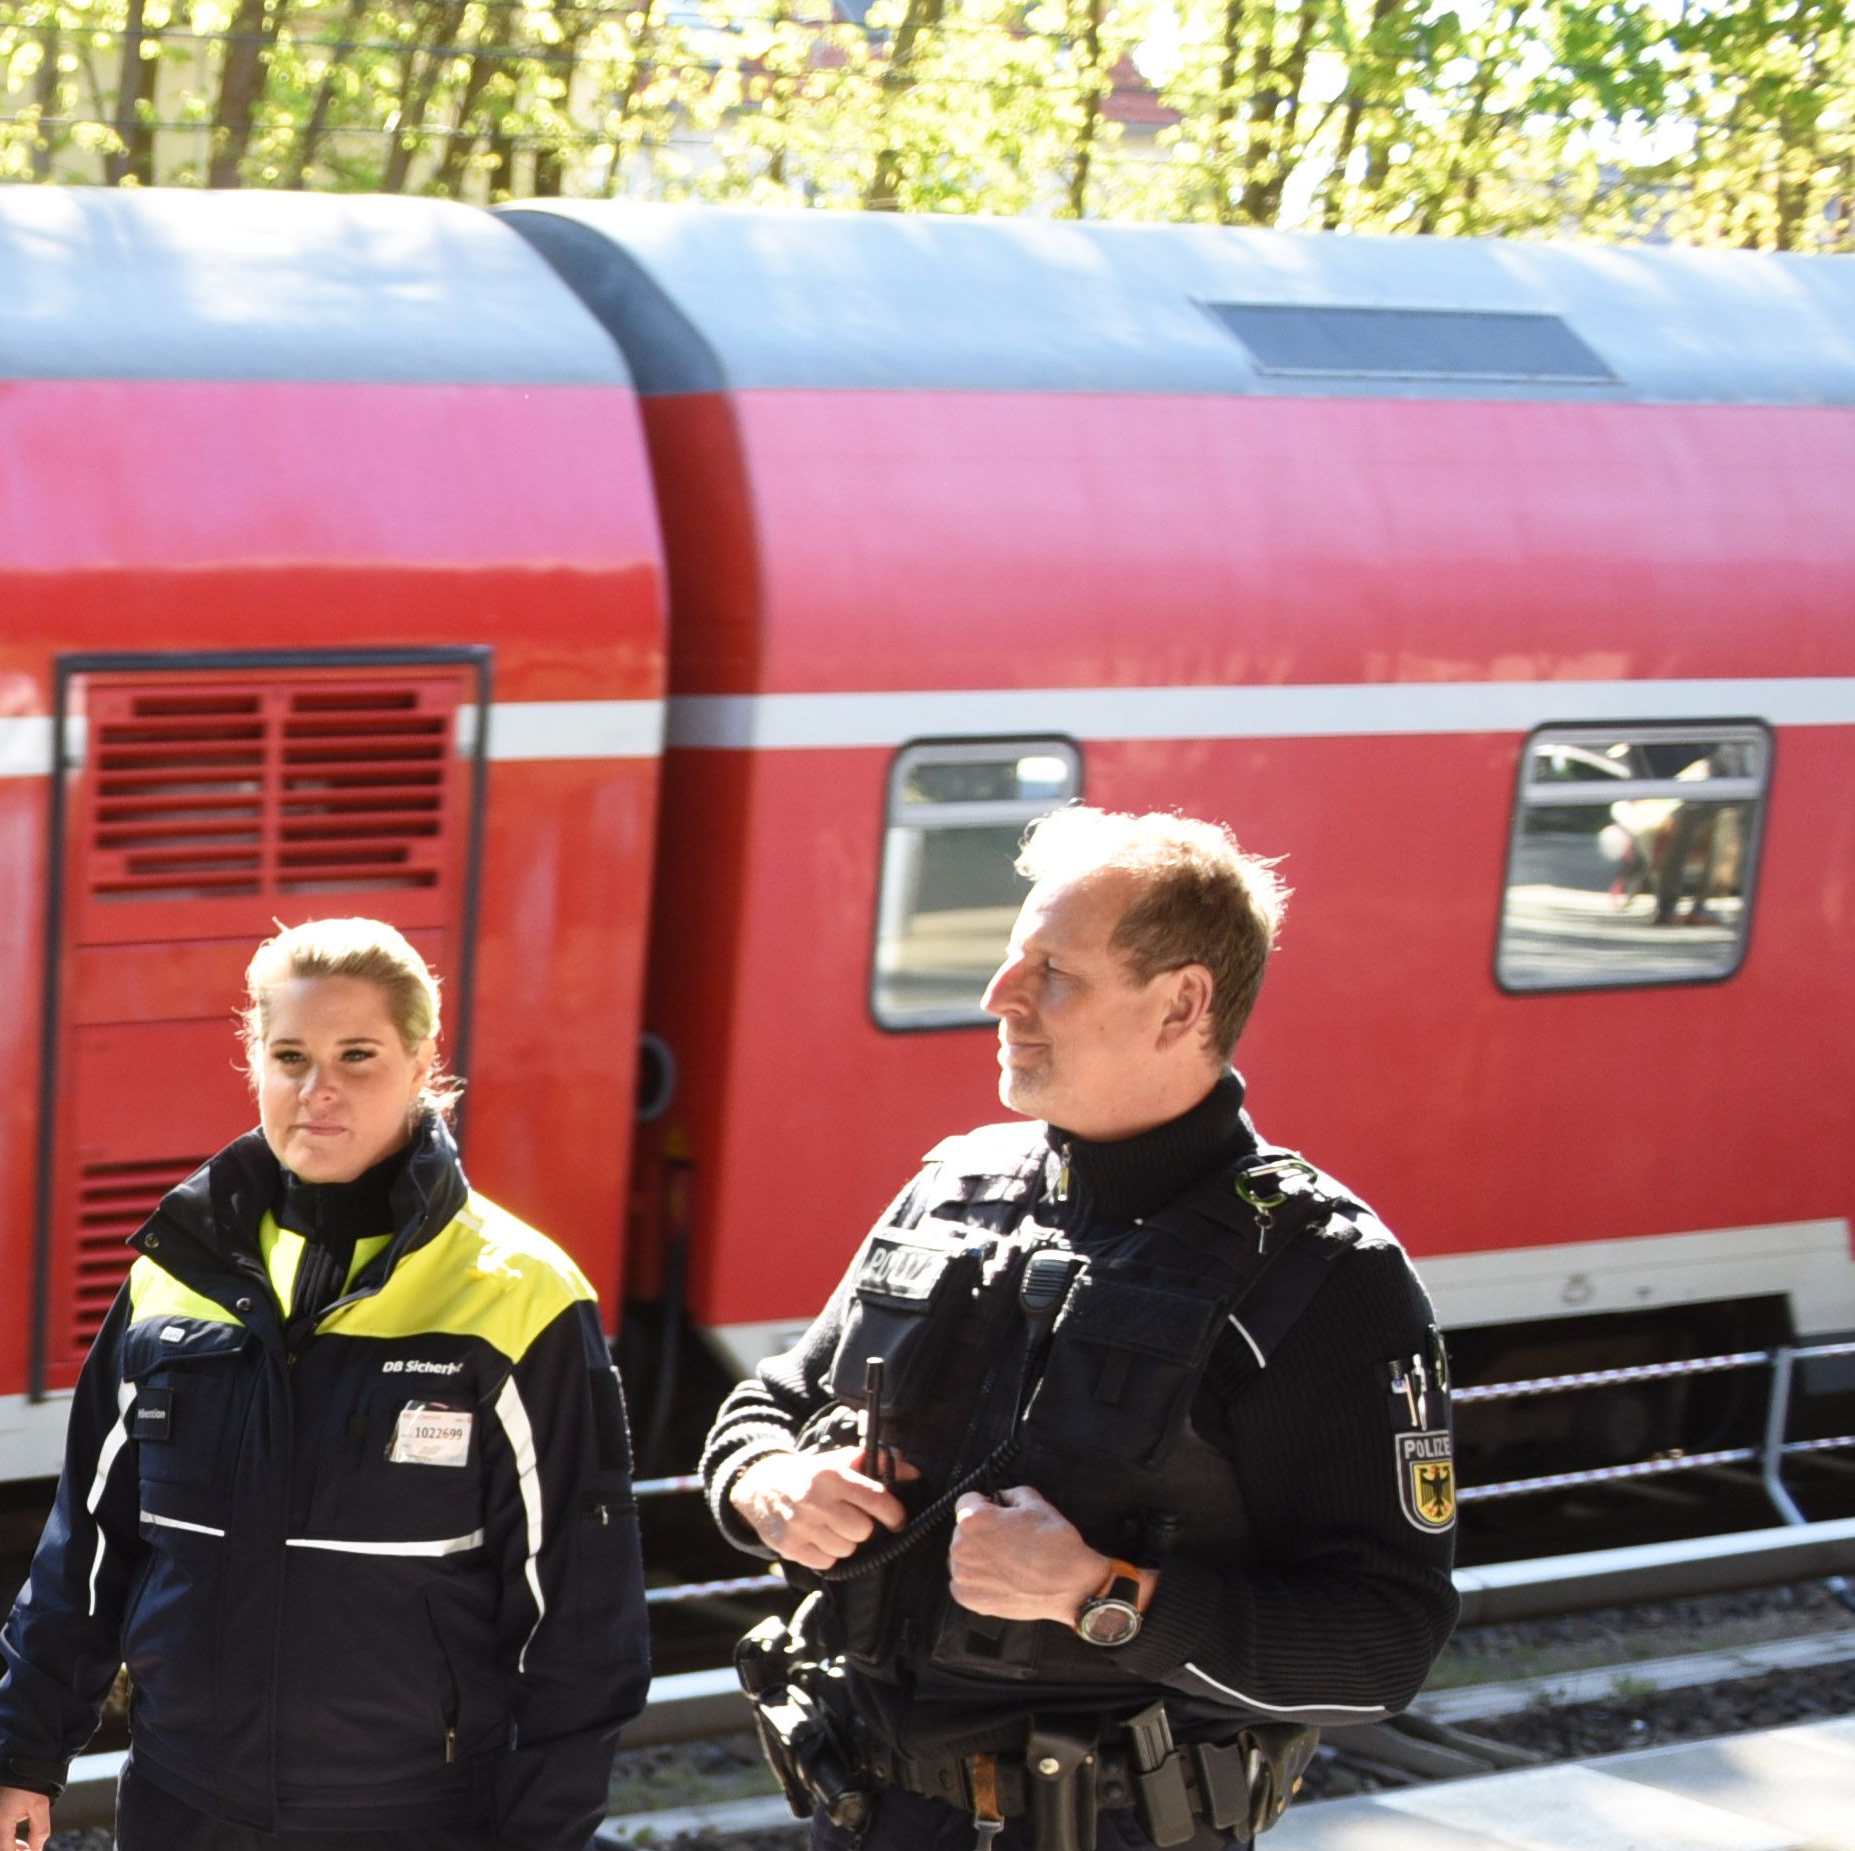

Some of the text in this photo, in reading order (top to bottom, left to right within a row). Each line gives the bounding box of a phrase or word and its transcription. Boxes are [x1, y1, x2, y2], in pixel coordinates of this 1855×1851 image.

[382, 1361, 404, 1373] DB
[415, 1427, 464, 1440] 1022699
[1404, 1437, 1451, 1459] POLIZE
